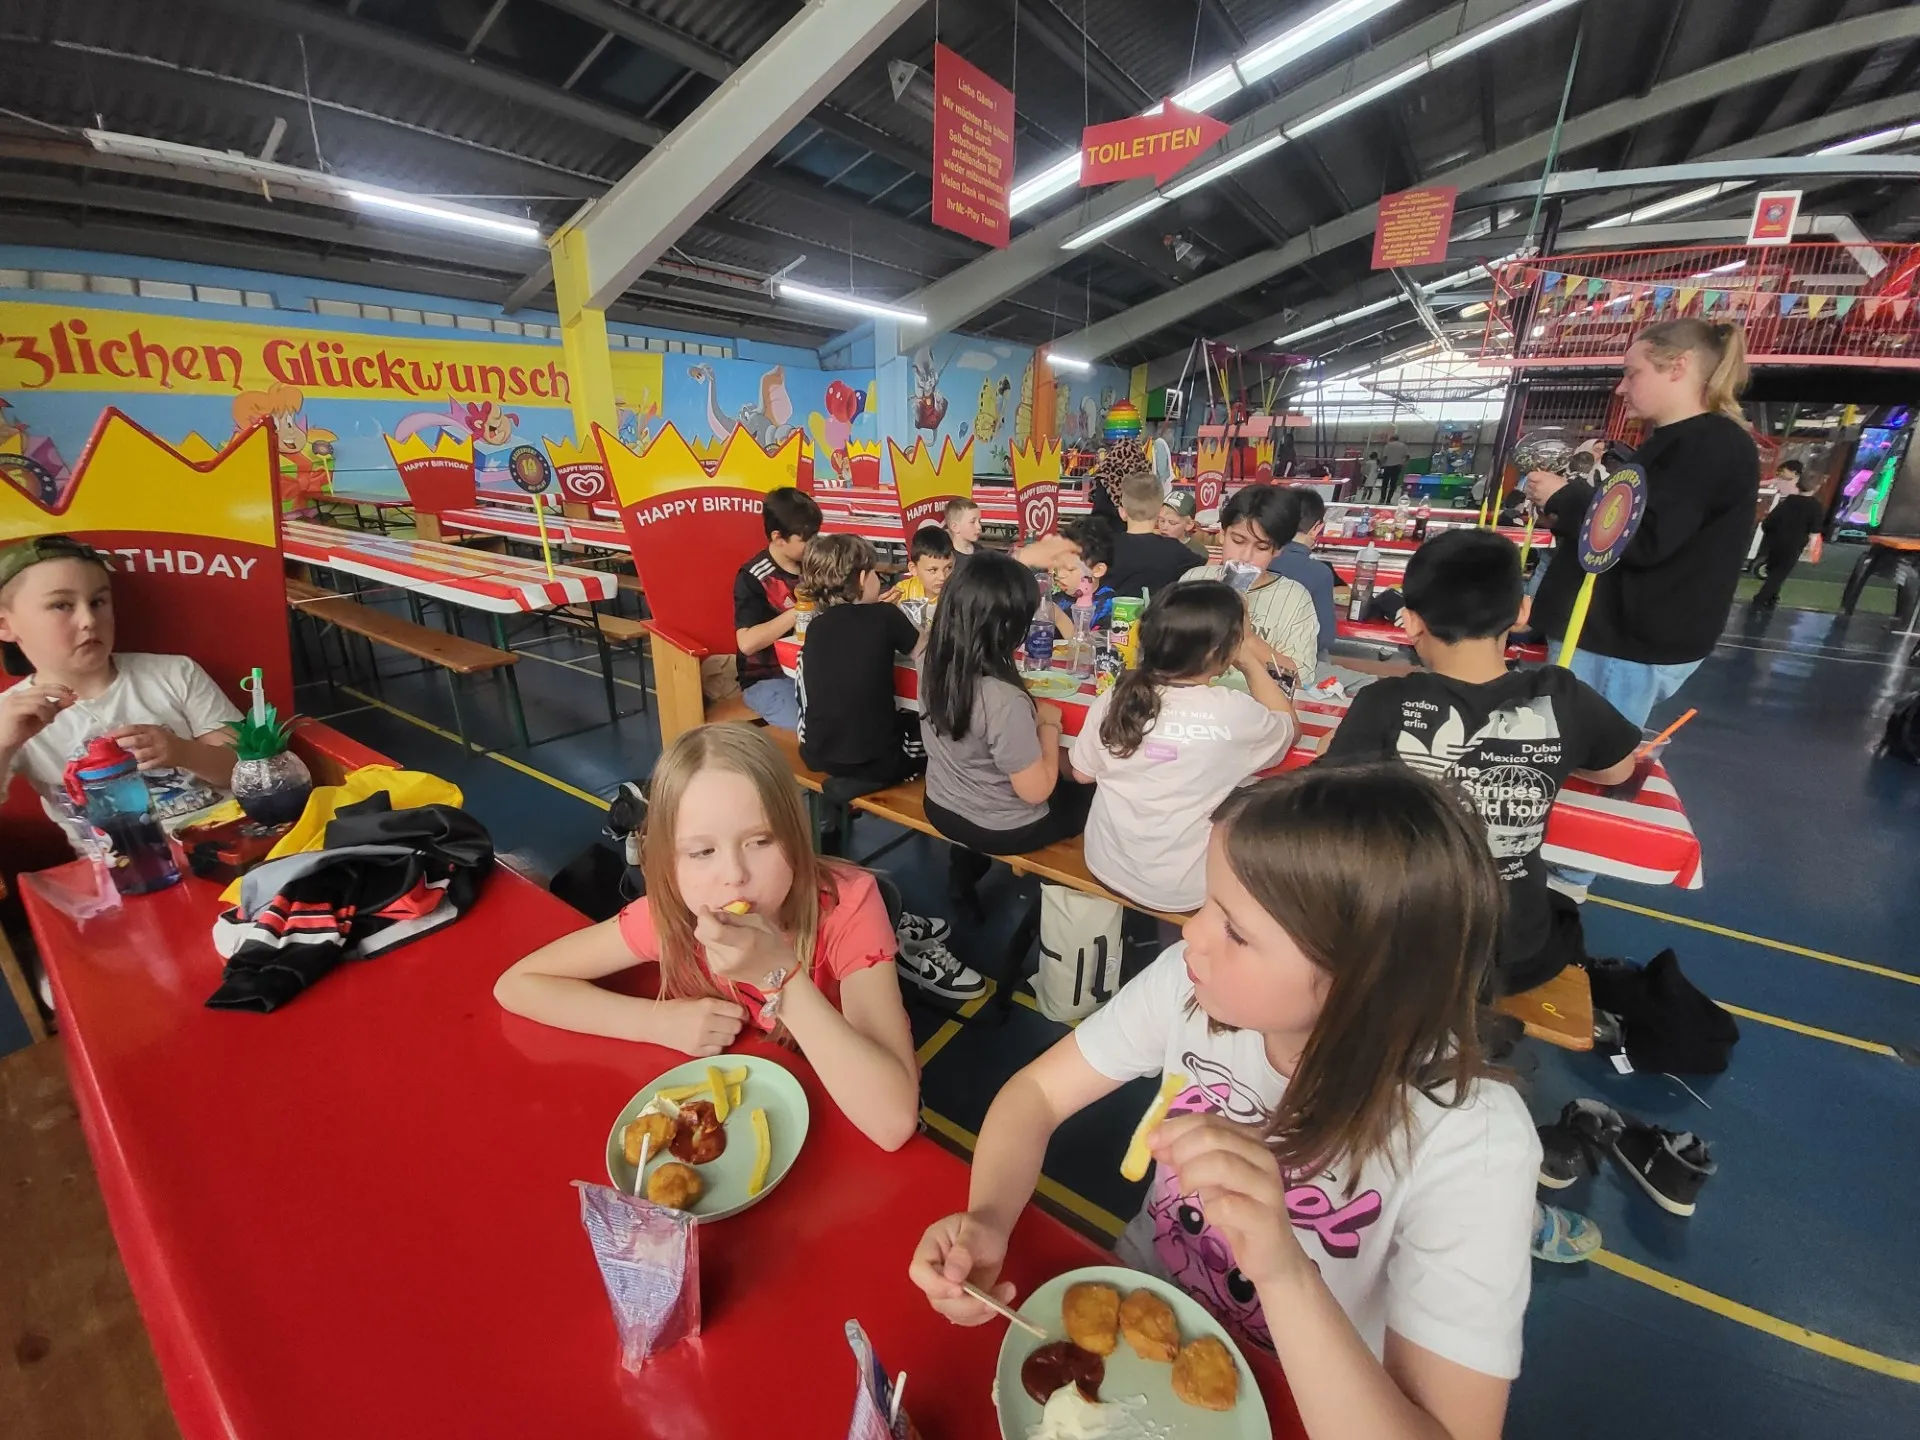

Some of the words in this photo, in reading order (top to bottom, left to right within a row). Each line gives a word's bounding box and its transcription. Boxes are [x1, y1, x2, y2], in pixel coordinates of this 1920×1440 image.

[942, 94, 954, 111] Wir
[1087, 125, 1201, 166] TOILETTEN
[940, 172, 961, 191] Vielen
[0, 318, 243, 391] zlichen
[262, 339, 571, 403] Glückwunsch
[403, 460, 429, 472] HAPPY
[430, 460, 469, 471] BIRTHDAY
[558, 464, 578, 475] HAPPY
[579, 464, 604, 472] BIRTHDA
[1019, 488, 1035, 503] HAPPY
[1035, 485, 1058, 495] BIRTHDAY
[636, 497, 698, 527] HAPPY
[702, 496, 764, 514] BIRTHD
[906, 504, 933, 522] HAPPY
[1602, 494, 1623, 529] 6
[95, 548, 257, 580] THDAY
[1402, 708, 1422, 719] aris
[1403, 718, 1428, 730] erlin
[1521, 743, 1561, 753] Dubai
[1480, 751, 1529, 763] Mexico
[1532, 753, 1562, 764] City
